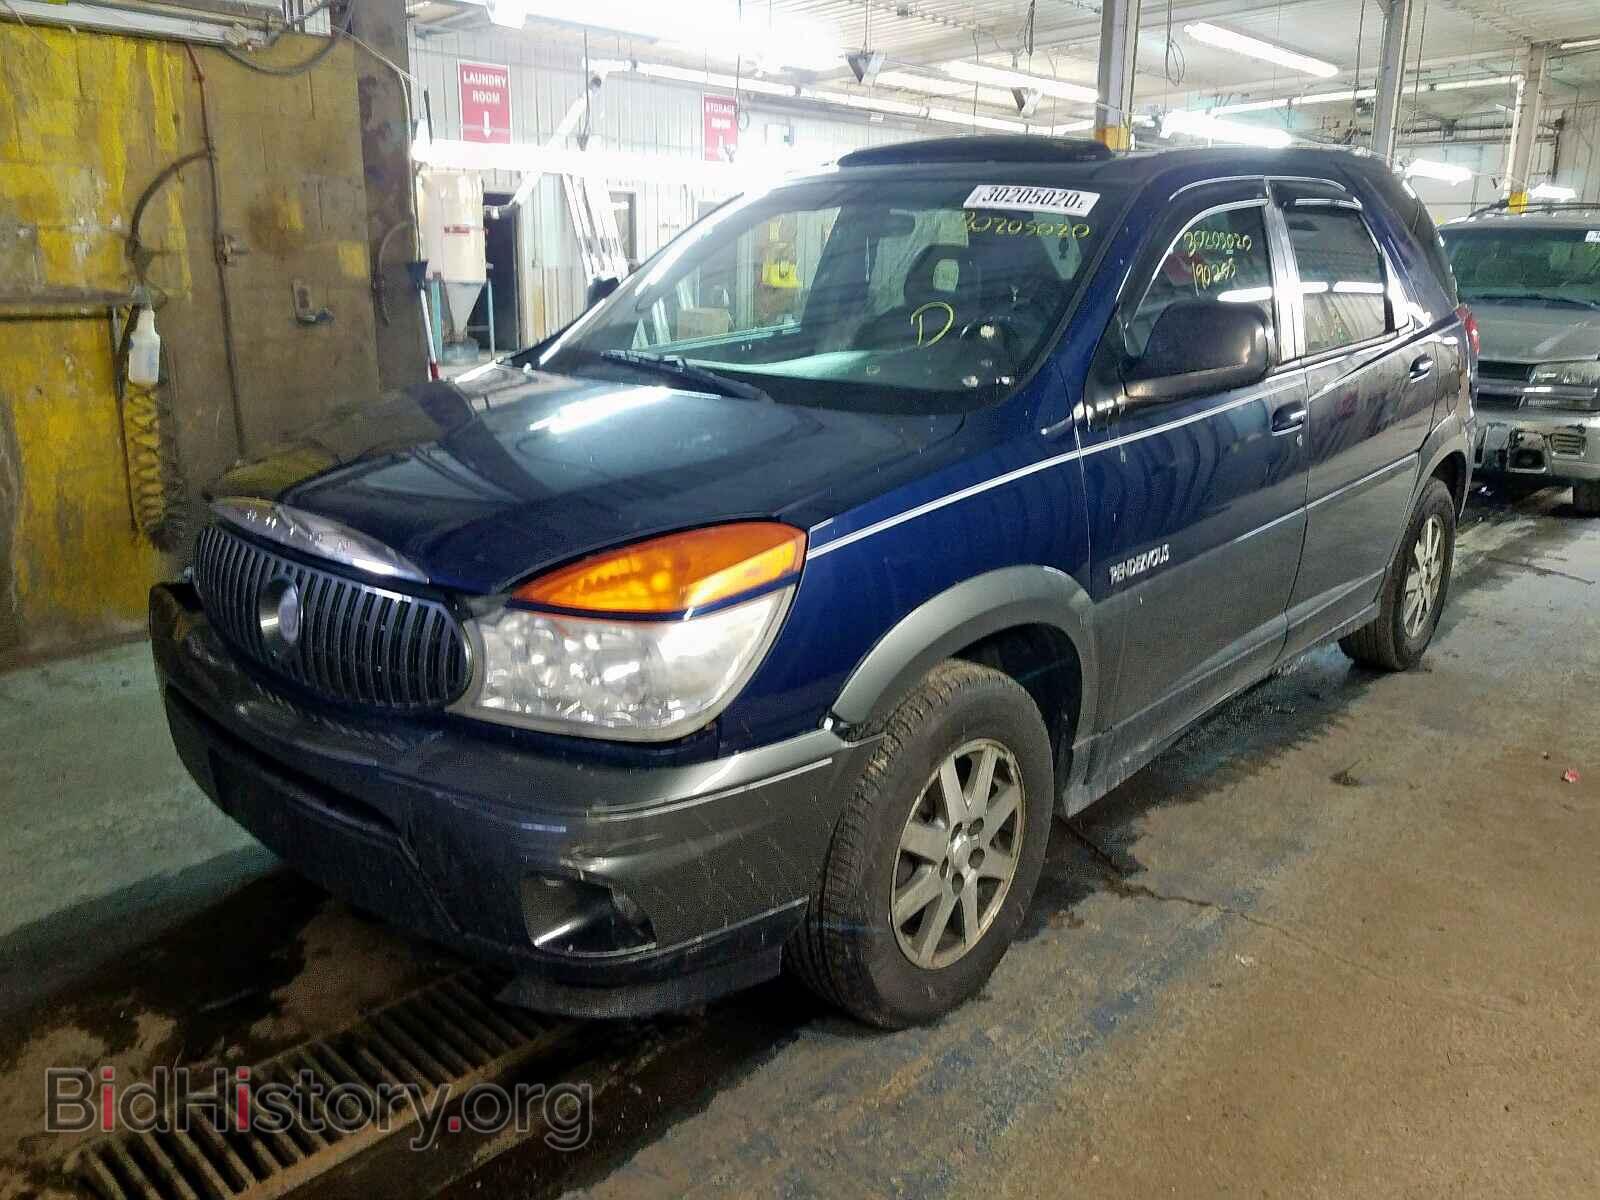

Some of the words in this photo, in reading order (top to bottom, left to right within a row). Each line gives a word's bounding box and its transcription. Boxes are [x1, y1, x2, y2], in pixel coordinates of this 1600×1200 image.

[463, 70, 507, 89] LAUNDRY
[472, 89, 501, 105] ROOM
[982, 186, 1081, 209] 30205020
[910, 301, 955, 348] D
[1109, 543, 1170, 585] RENDEZVOUS
